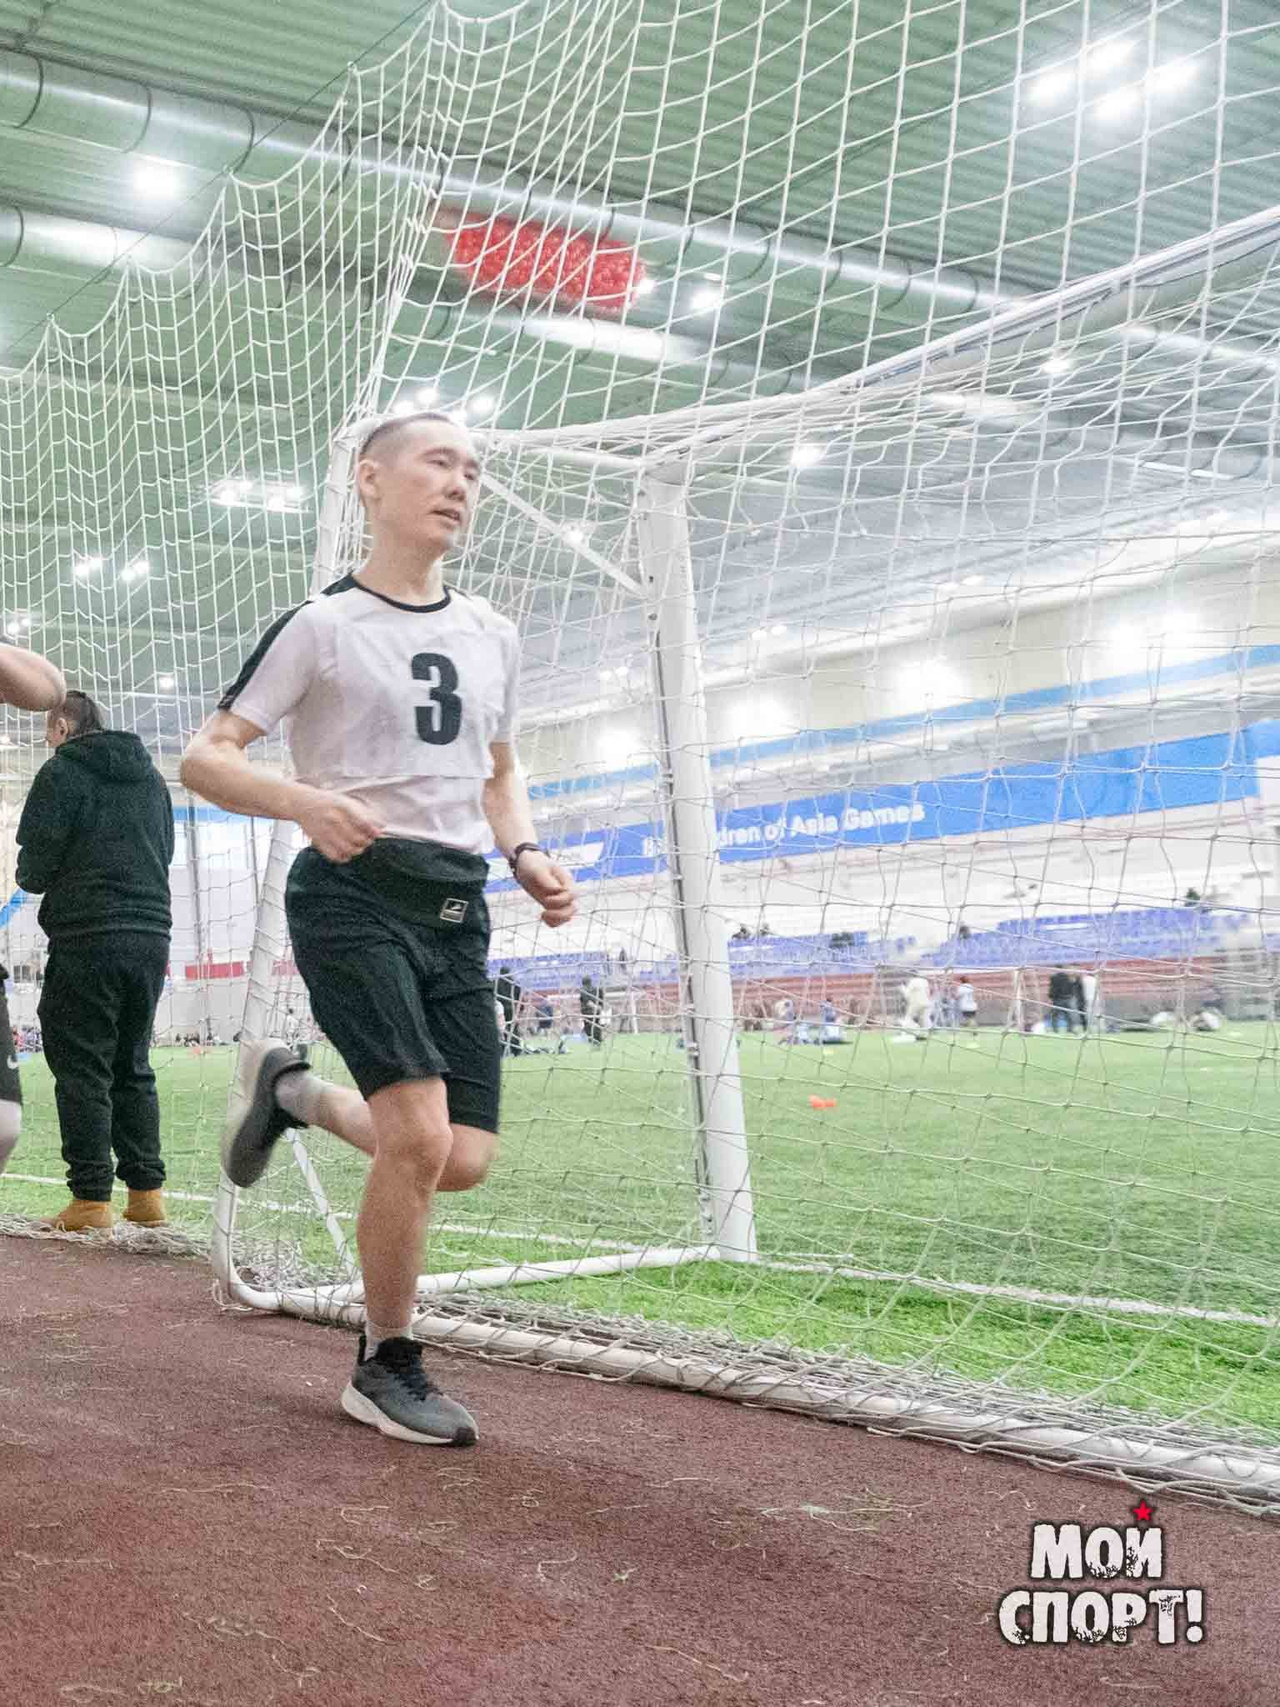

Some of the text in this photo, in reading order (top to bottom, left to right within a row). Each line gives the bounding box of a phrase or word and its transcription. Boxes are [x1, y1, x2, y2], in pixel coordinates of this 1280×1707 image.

[411, 652, 463, 745] 3
[764, 815, 787, 841] of
[790, 812, 840, 838] Asia
[843, 802, 926, 832] Games
